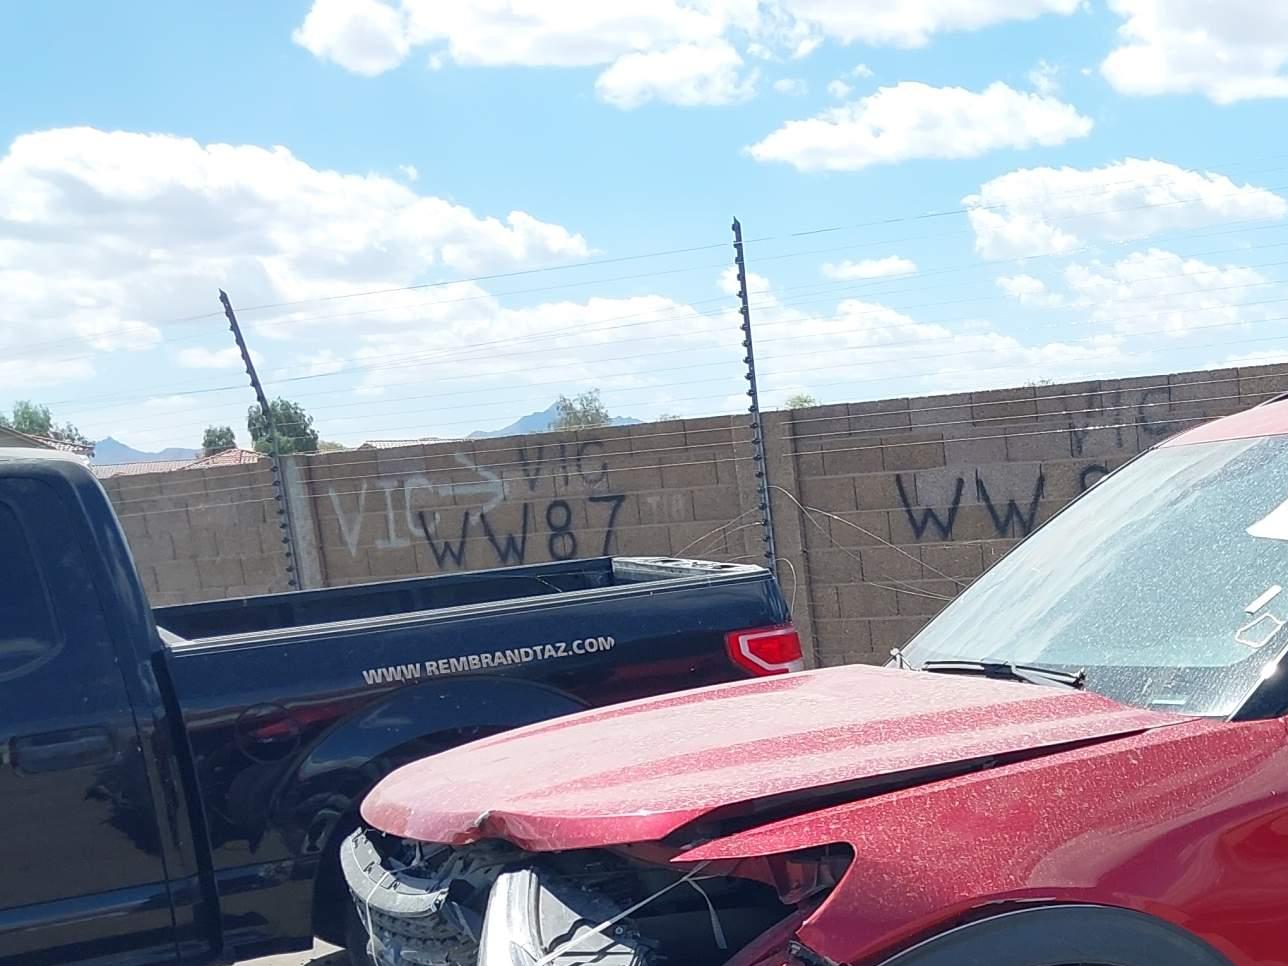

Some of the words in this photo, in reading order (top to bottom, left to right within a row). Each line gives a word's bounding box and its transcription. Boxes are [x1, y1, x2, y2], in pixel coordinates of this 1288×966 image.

[517, 440, 608, 493] VIC
[328, 474, 440, 558] VIC
[362, 663, 421, 685] WWW
